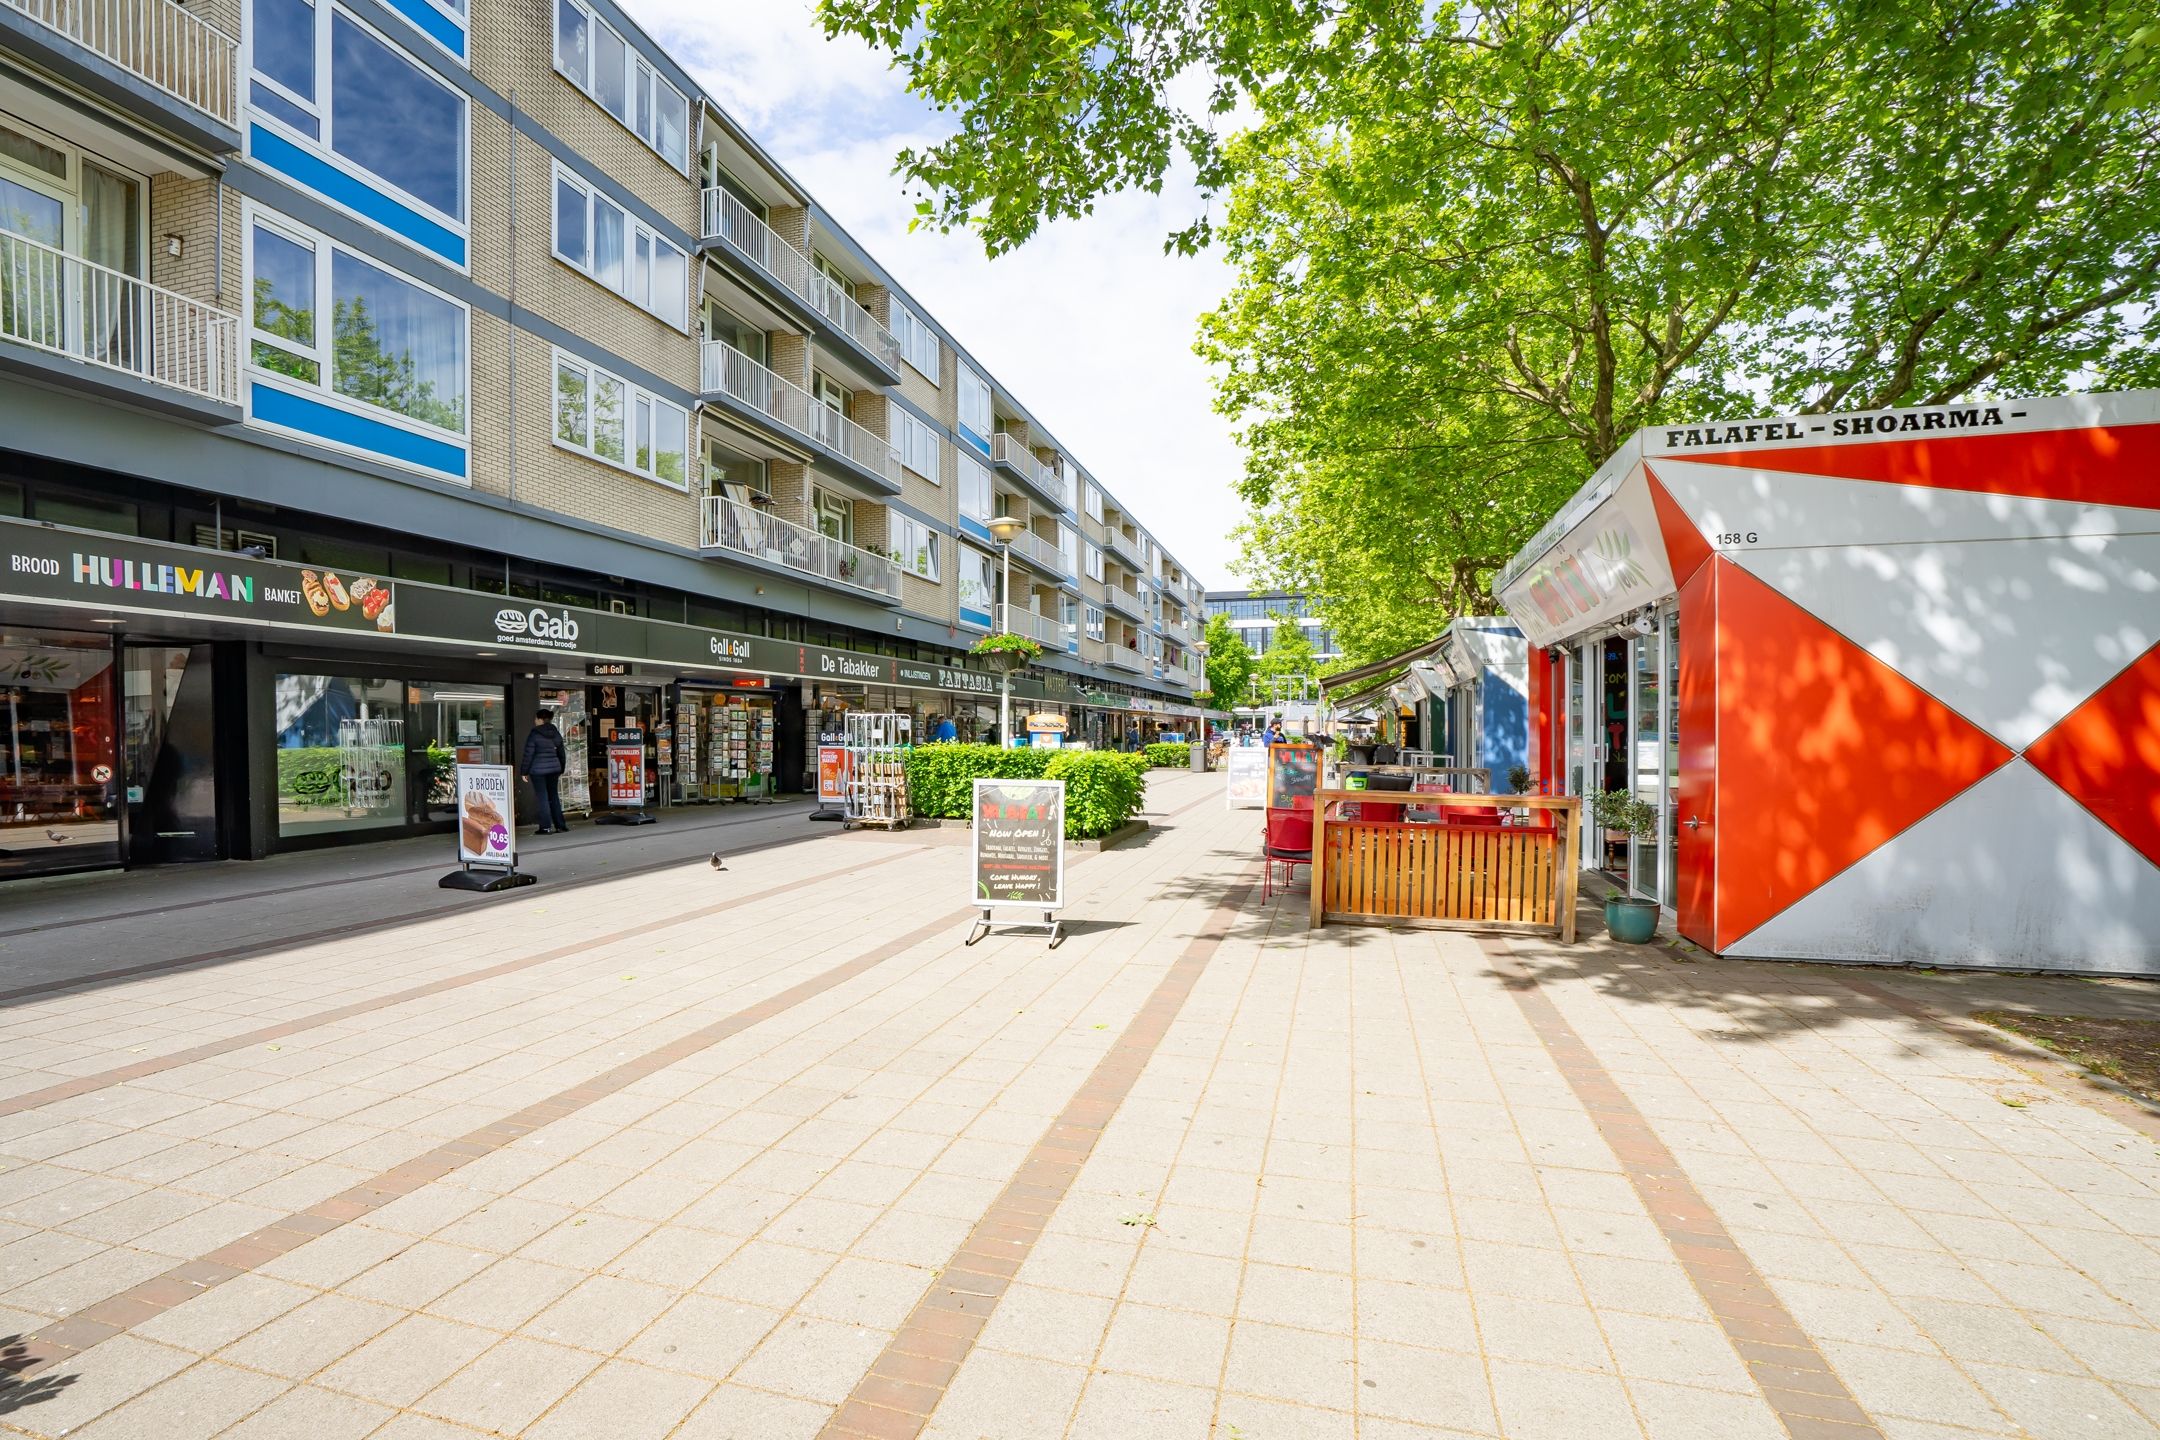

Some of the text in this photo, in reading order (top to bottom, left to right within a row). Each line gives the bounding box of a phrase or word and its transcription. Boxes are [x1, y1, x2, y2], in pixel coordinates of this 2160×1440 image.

[1666, 422, 1804, 448] FALAFEL
[1833, 407, 2004, 437] SHOARMA
[1716, 532, 1758, 545] 158 G
[11, 552, 302, 605] BROOD HULLEMAN BANKET
[528, 608, 579, 641] Gab
[515, 636, 554, 647] amsterdams
[554, 641, 577, 650] broodje
[821, 654, 880, 678] De Tabakker
[938, 669, 993, 692] FANTASIA
[469, 777, 505, 791] 3 BRODEN
[489, 831, 509, 844] 10,65
[989, 829, 1012, 838] NOW
